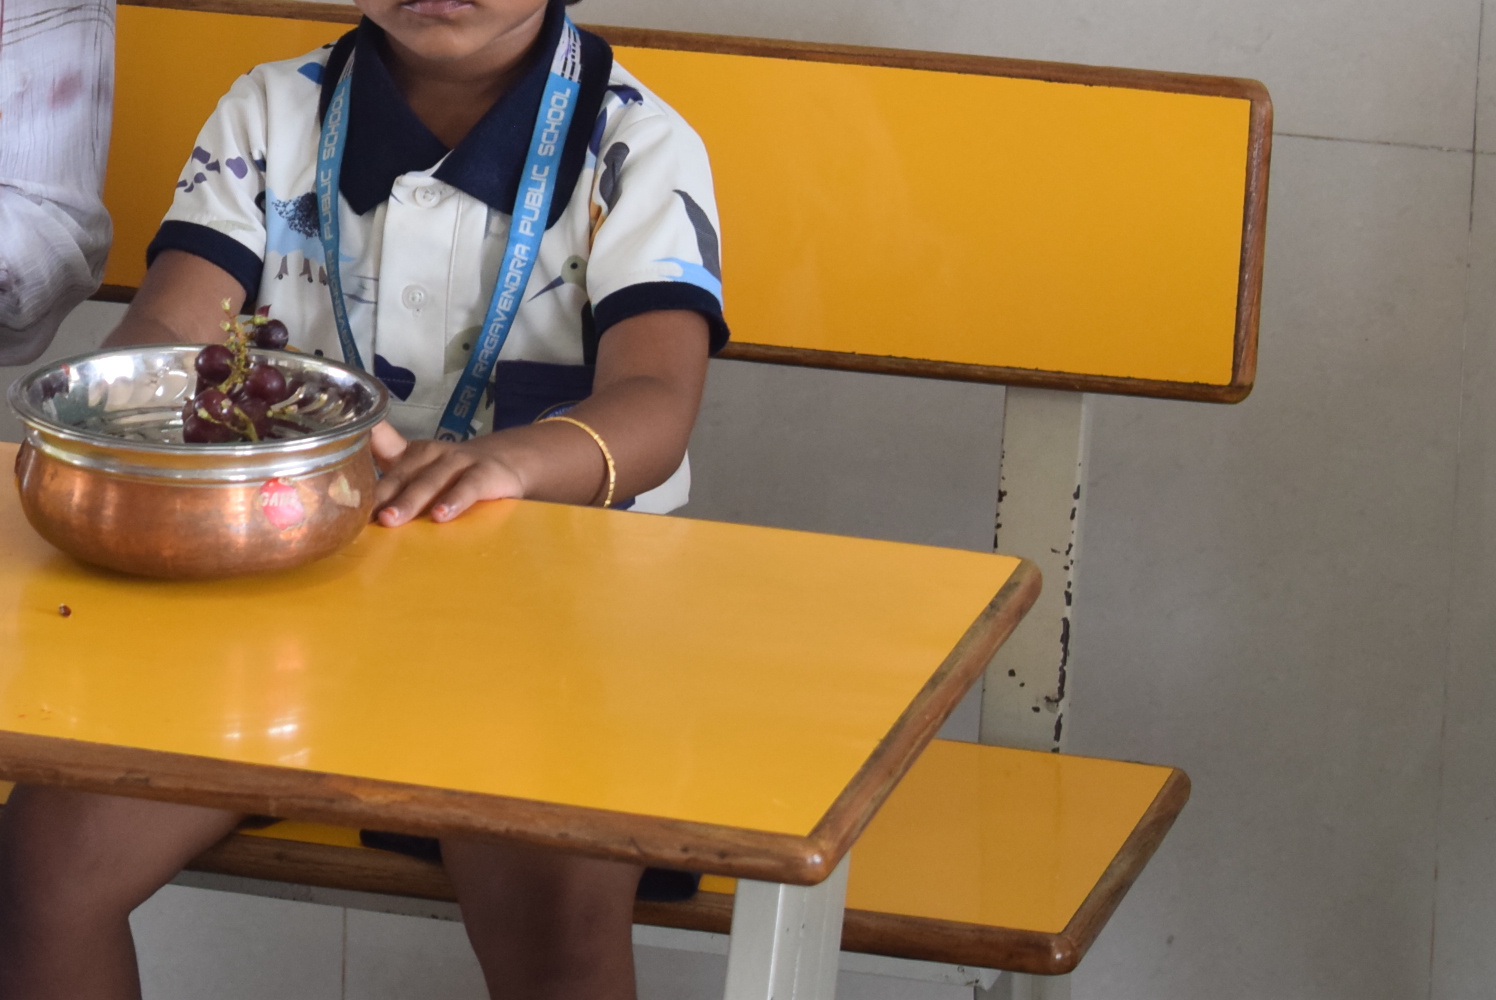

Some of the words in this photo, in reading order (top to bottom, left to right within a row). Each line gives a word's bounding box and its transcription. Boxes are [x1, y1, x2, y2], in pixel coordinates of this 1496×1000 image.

[322, 86, 346, 162] SCHOOL
[320, 169, 333, 241] PUBLIC
[454, 385, 477, 419] SRI
[471, 243, 532, 379] RAGAVENDRA
[518, 164, 550, 237] PUBLIC
[537, 87, 572, 158] SCHOOL
